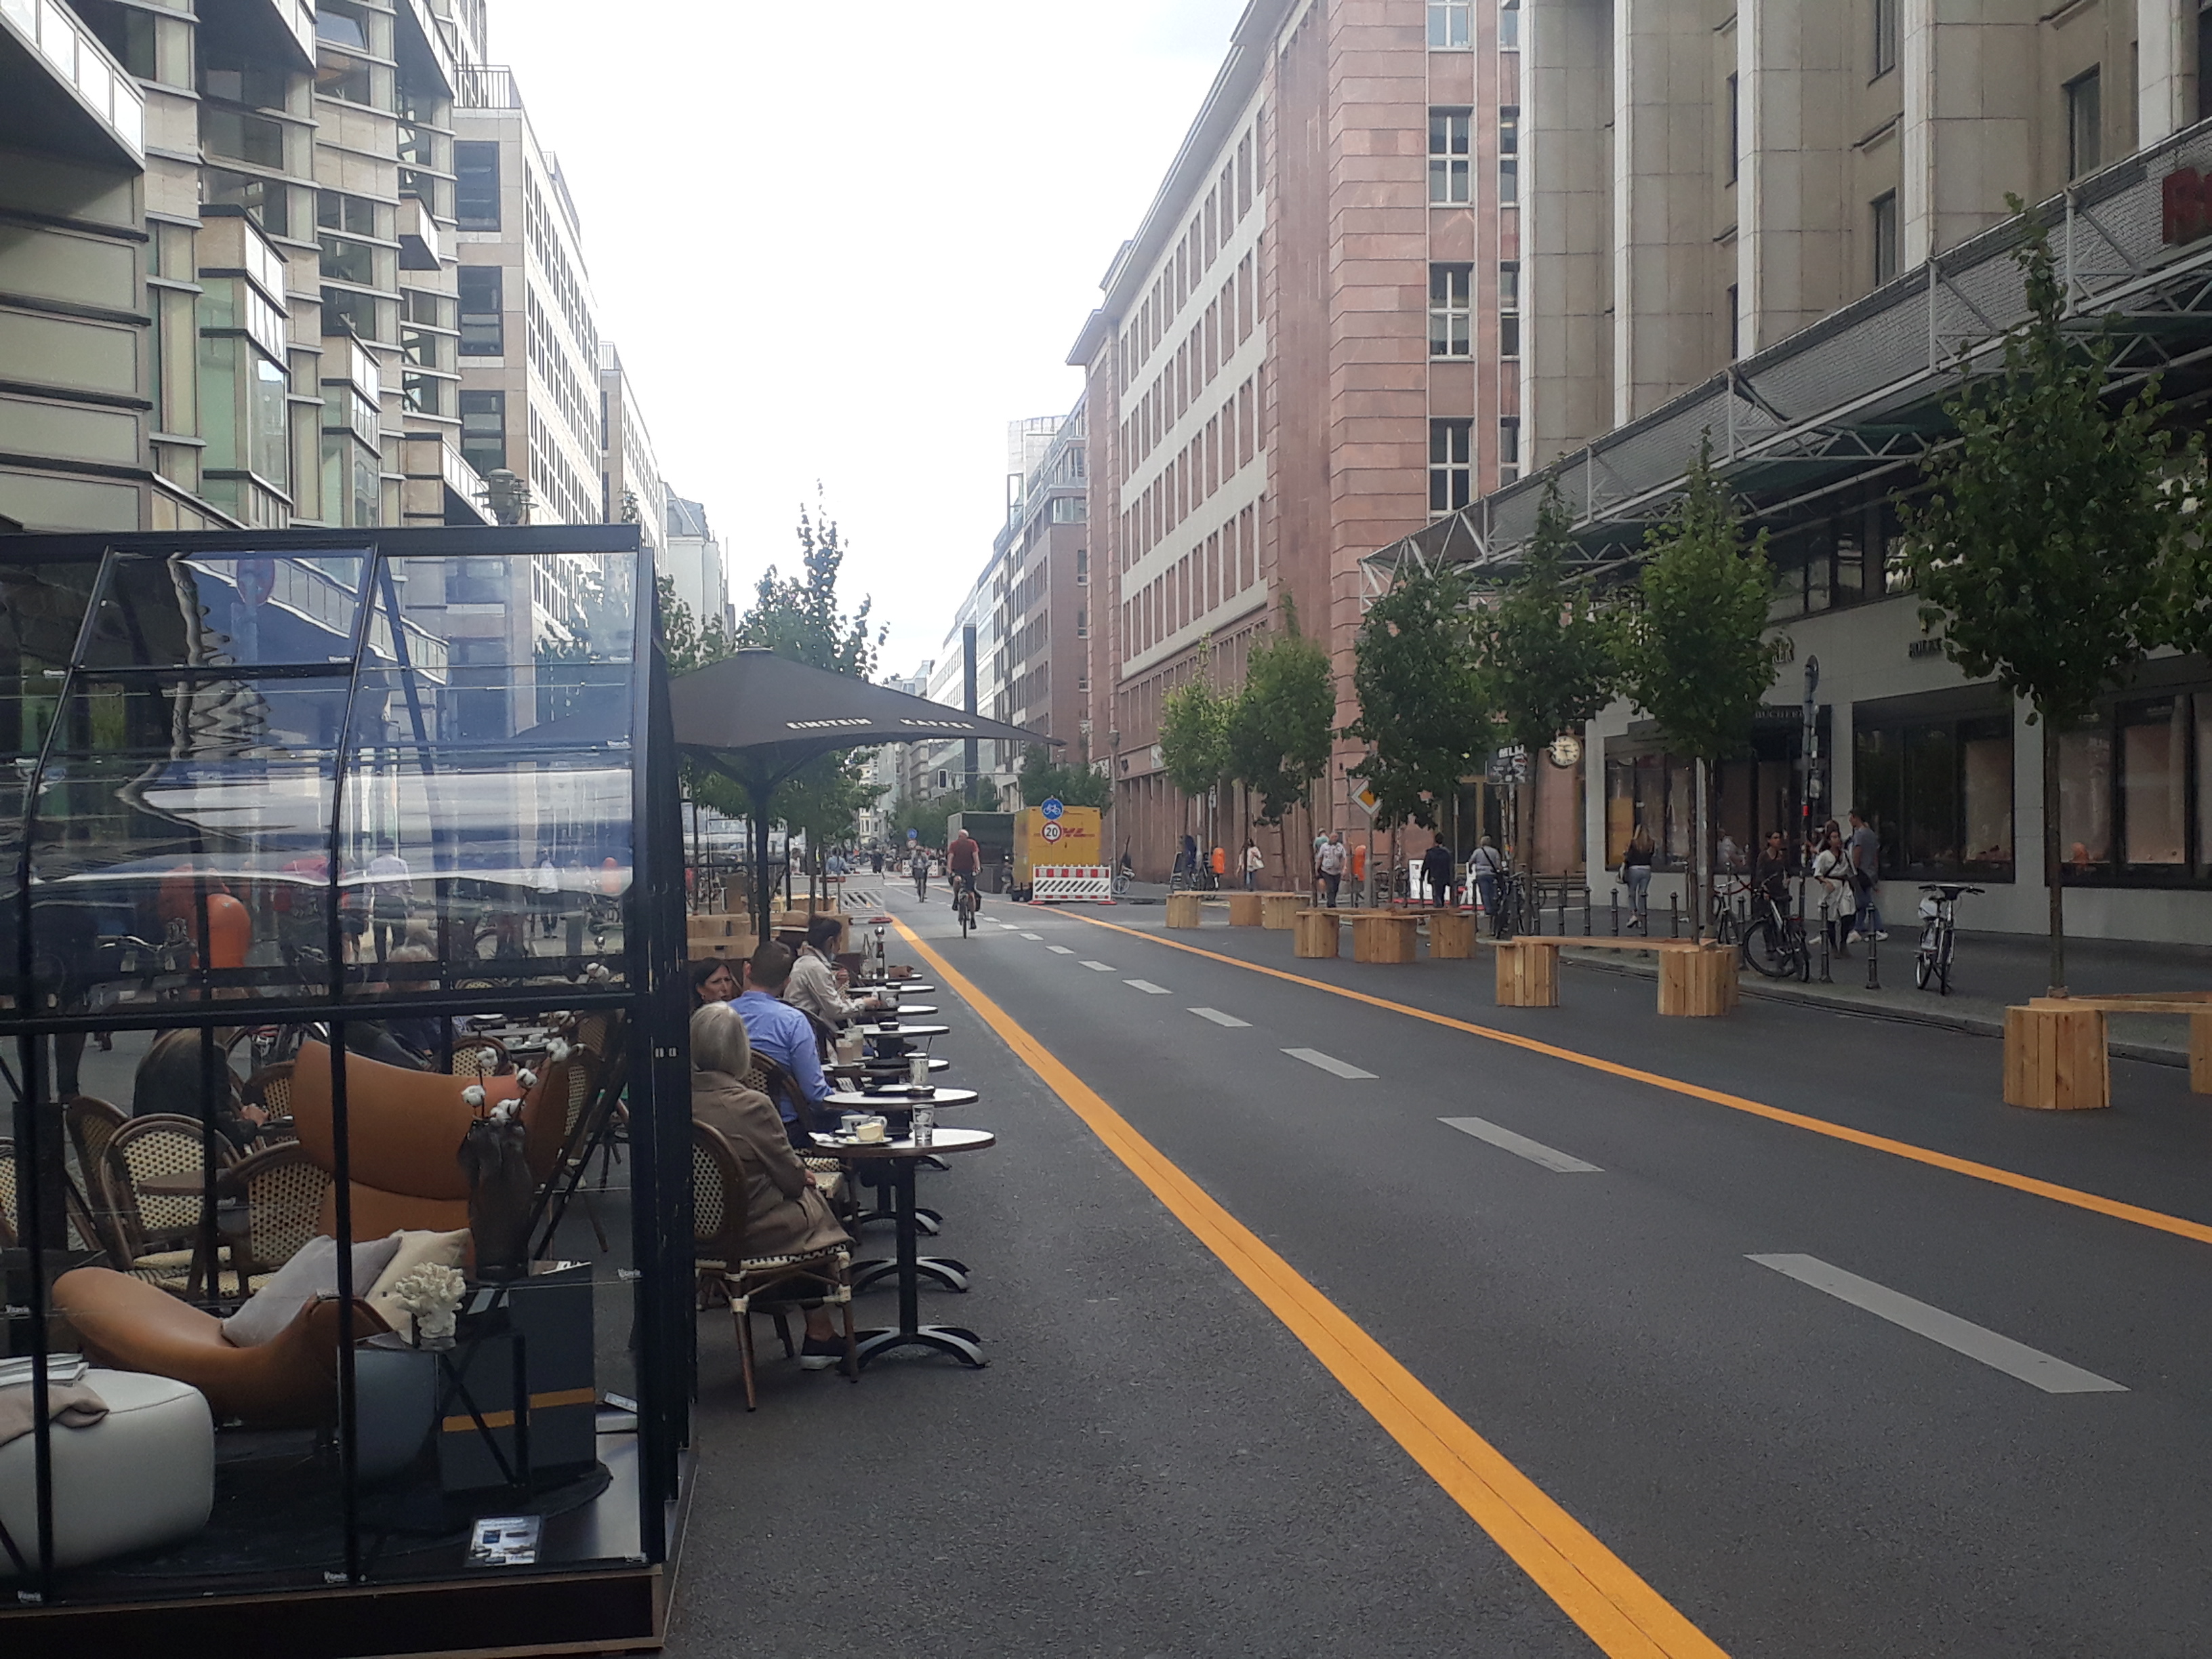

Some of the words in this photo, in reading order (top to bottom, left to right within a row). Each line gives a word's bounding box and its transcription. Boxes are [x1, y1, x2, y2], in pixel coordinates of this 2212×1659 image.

[785, 718, 873, 730] EINSTEIN
[899, 718, 975, 730] KAFFEE
[1046, 827, 1058, 837] 20
[1063, 827, 1086, 838] HL
